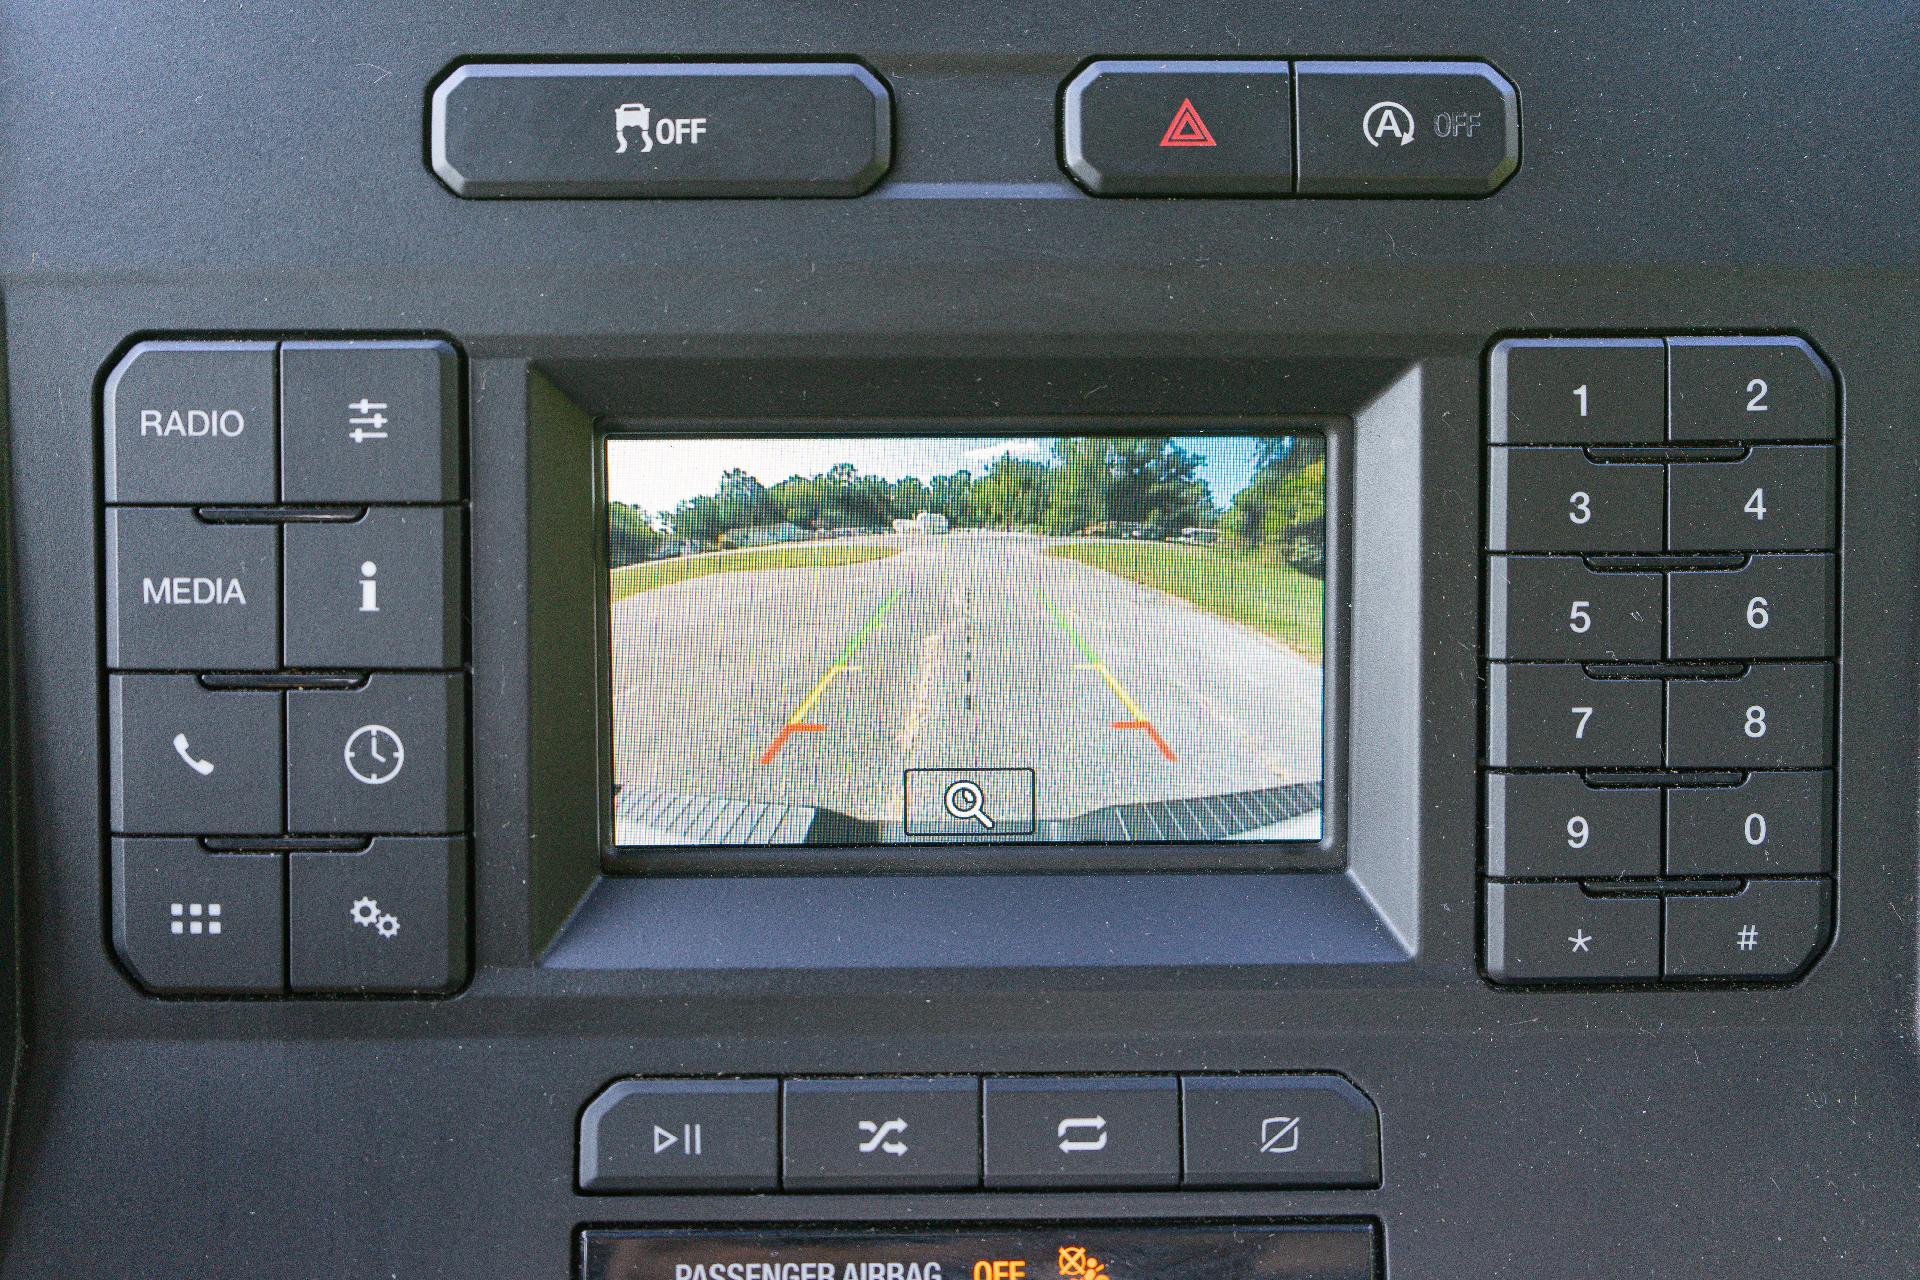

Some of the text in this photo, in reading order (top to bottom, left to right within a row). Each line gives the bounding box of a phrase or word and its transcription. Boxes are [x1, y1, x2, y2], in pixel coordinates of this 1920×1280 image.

[655, 118, 707, 145] OFF
[1434, 111, 1482, 138] OFF
[1573, 384, 1588, 417] 1
[1746, 378, 1769, 411] 2
[140, 409, 245, 437] RADIO
[1569, 491, 1592, 524] 3
[1743, 487, 1767, 520] 4
[142, 577, 247, 605] MEDIA
[1569, 601, 1592, 634] 5
[1746, 596, 1769, 629] 6
[1571, 707, 1593, 739] 7
[1744, 705, 1767, 738] 8
[1566, 815, 1589, 849] 9
[1744, 812, 1767, 846] 0
[675, 1260, 1026, 1280] PASSENGER AIRBAG OFF
